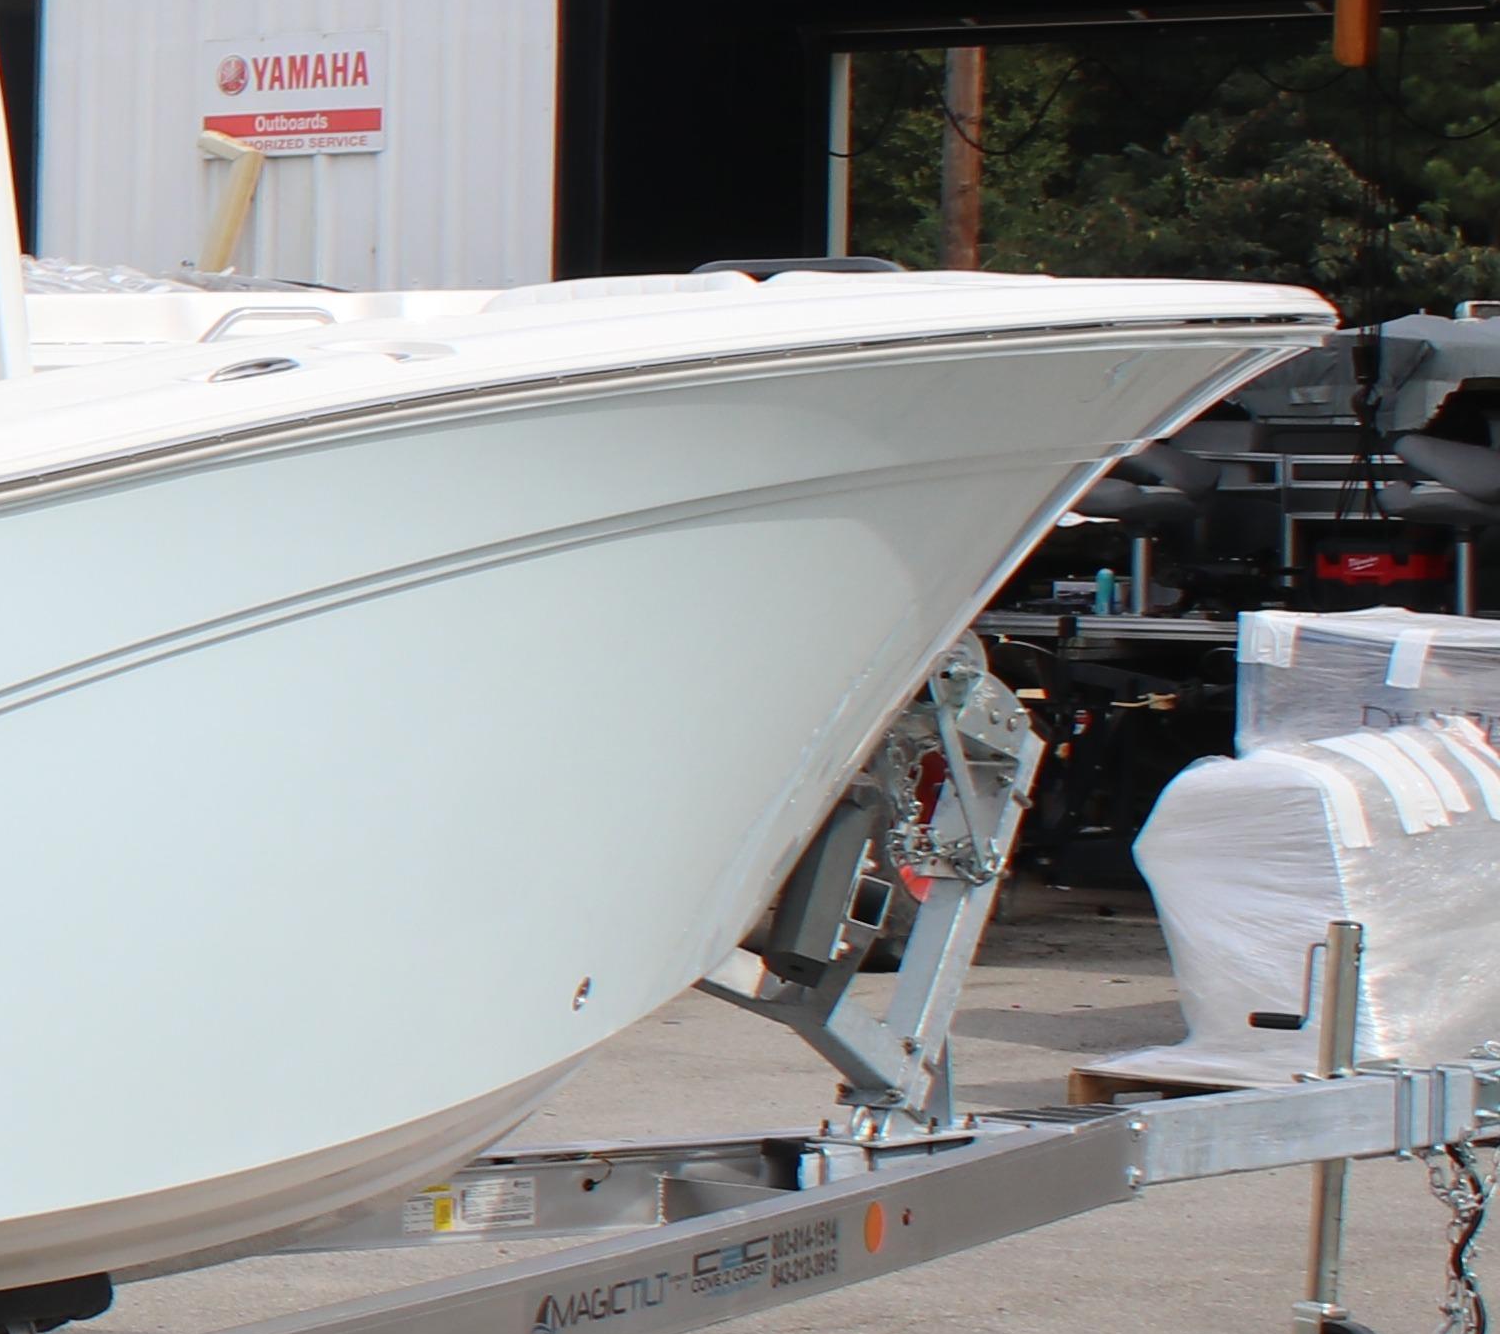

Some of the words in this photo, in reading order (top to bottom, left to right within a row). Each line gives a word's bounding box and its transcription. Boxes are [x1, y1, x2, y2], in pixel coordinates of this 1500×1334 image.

[251, 51, 370, 92] YAMAHA
[254, 113, 329, 133] Outboards
[308, 135, 368, 148] SERVICE
[551, 1271, 668, 1329] MAGICTILT
